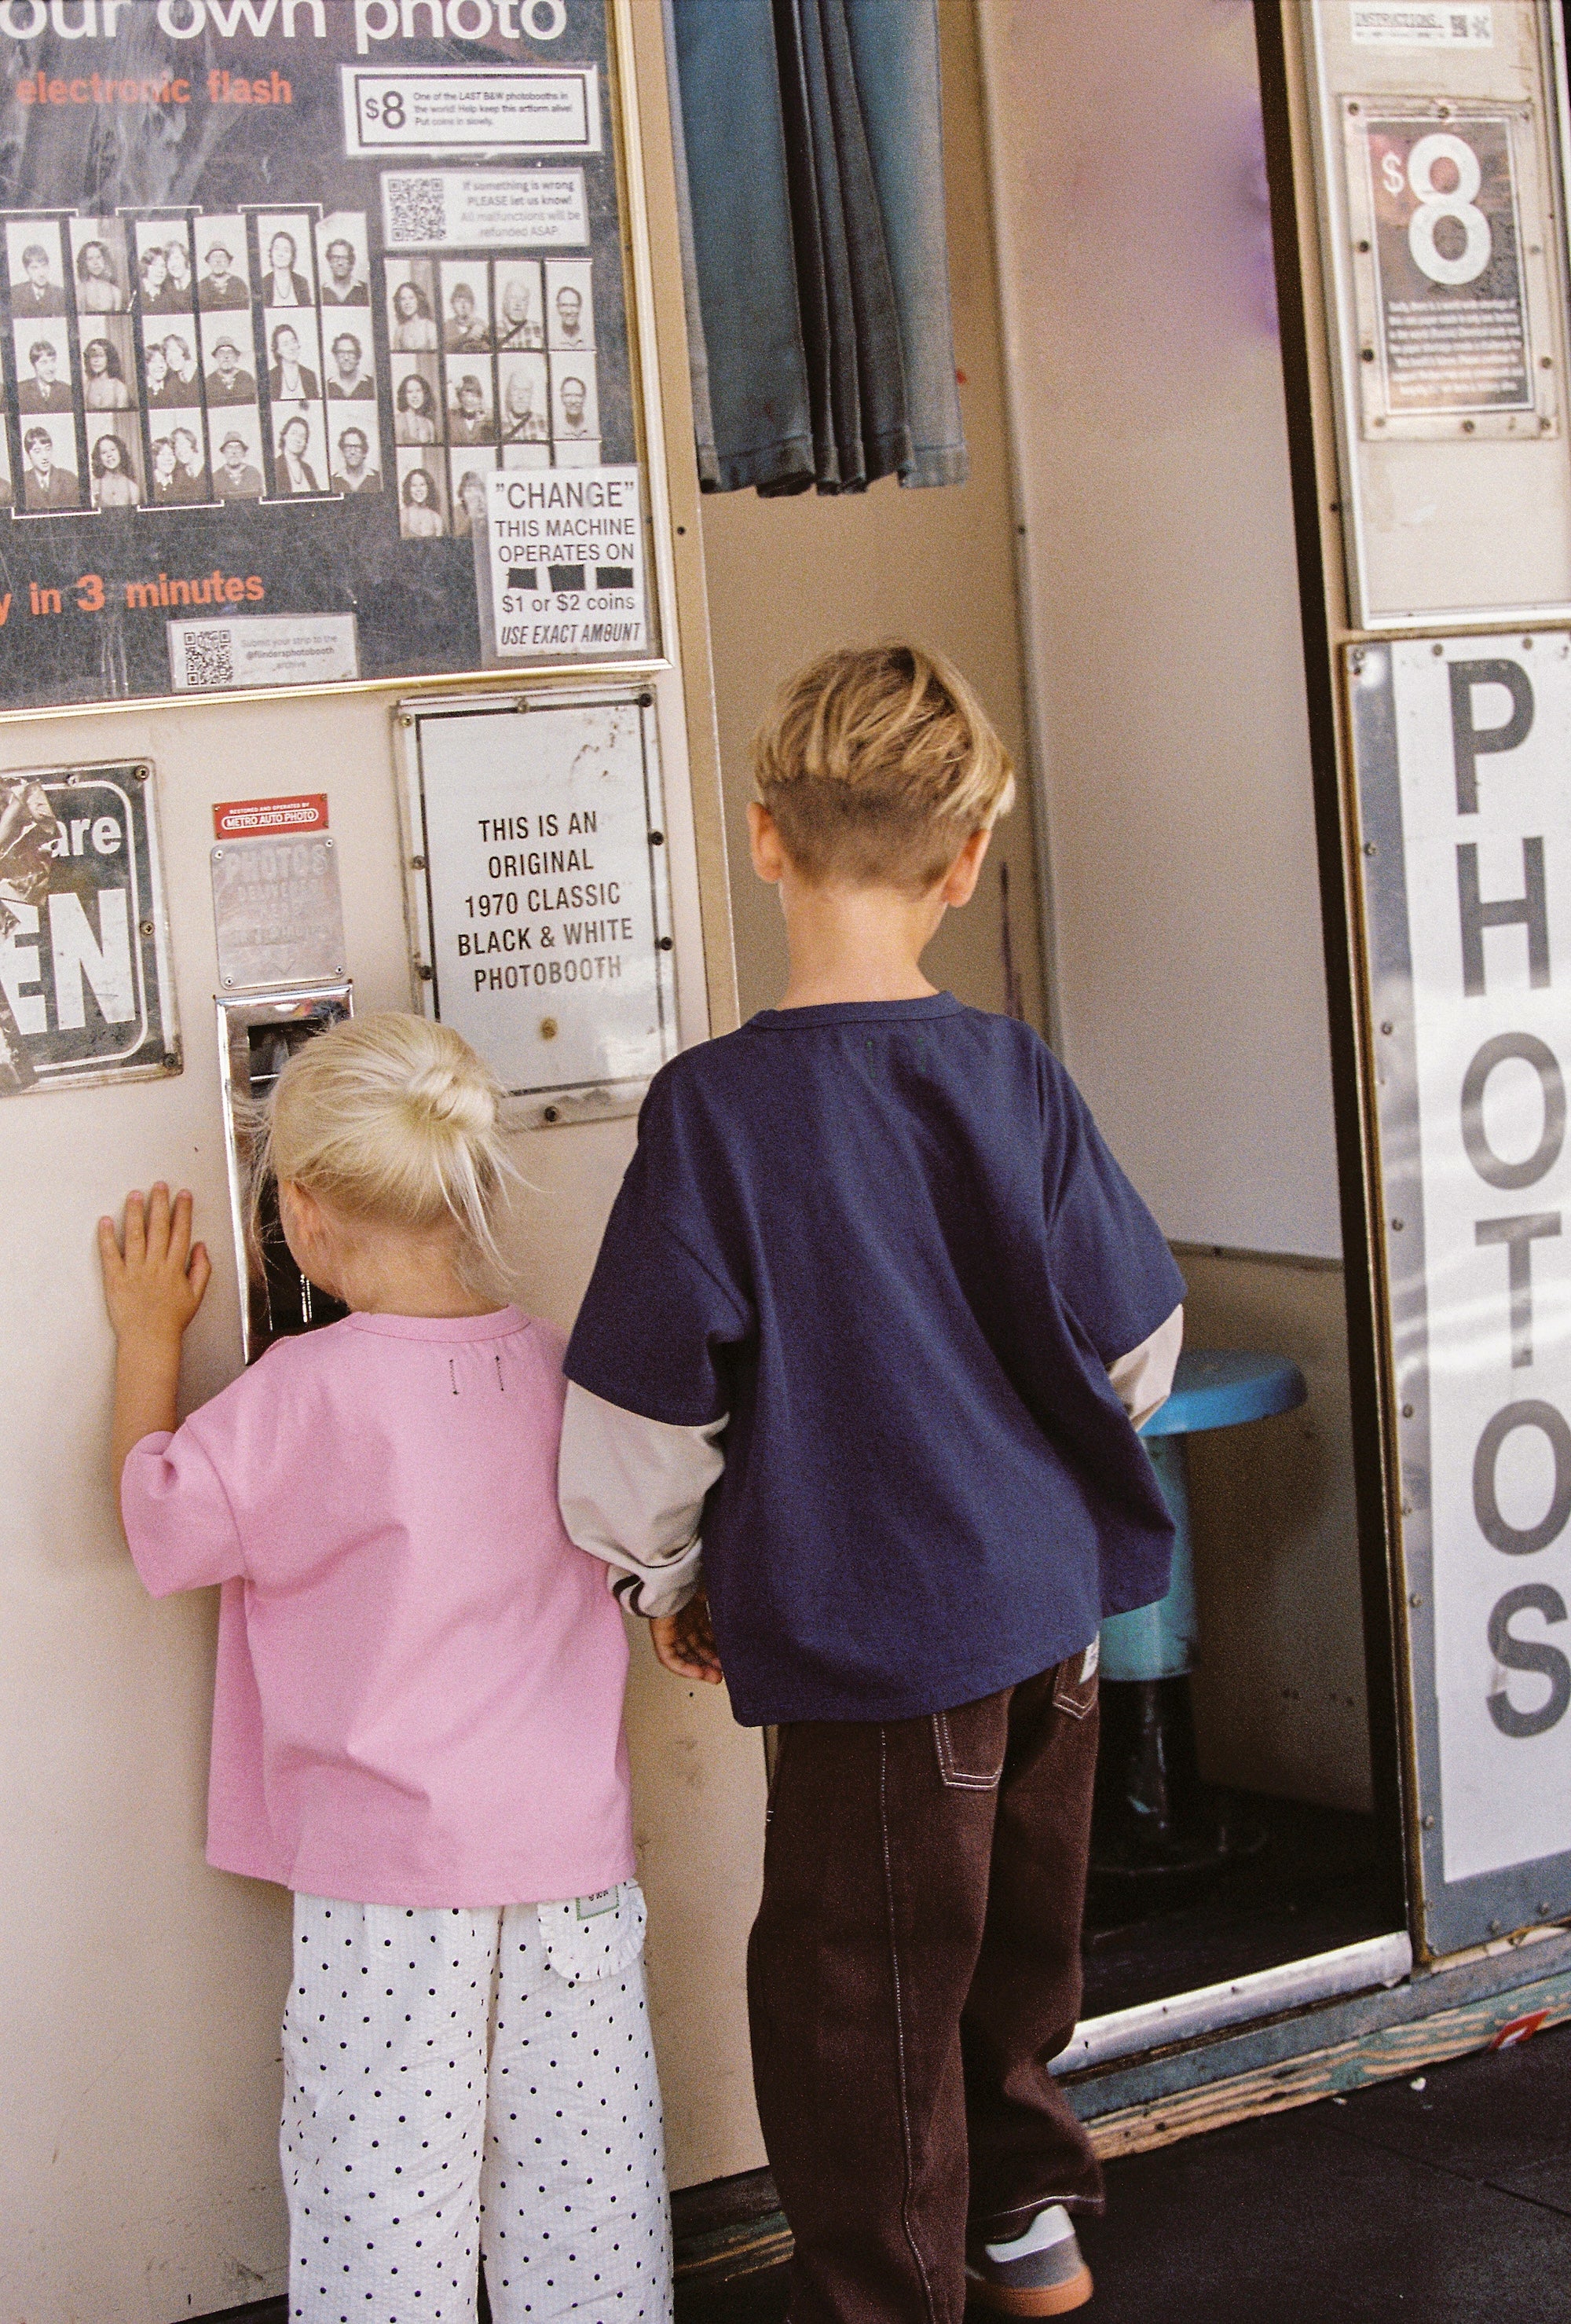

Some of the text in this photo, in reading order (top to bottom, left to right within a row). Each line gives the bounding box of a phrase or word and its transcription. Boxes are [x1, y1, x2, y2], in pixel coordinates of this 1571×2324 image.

[157, 0, 326, 39] own
[356, 0, 566, 54] photo
[16, 69, 292, 104] electronic flash
[413, 92, 430, 101] One
[443, 92, 457, 101] the
[459, 92, 481, 101] LAST
[484, 92, 503, 101] B&W
[506, 92, 558, 102] photobooths
[561, 92, 568, 101] in
[364, 90, 406, 130] $8
[414, 104, 428, 113] the
[479, 104, 500, 115] keep
[502, 104, 516, 113] this
[416, 117, 430, 126] Put
[474, 181, 529, 192] something
[532, 181, 540, 190] is
[542, 181, 574, 192] wrong
[467, 196, 508, 206] PLEASE
[511, 196, 524, 206] let
[527, 197, 540, 206] us
[1383, 133, 1492, 285] $8
[547, 210, 565, 221] will
[567, 211, 580, 221] be
[480, 226, 528, 237] refunded
[494, 519, 635, 537] THIS MACHINE
[499, 543, 634, 563] OPERATES ON
[29, 582, 61, 615] in
[77, 574, 105, 611] 3
[126, 570, 265, 609] minutes
[502, 592, 635, 614] $1 or $2 coins
[501, 622, 641, 645] USE EXACT AMOUNT
[226, 811, 315, 827] METRO AUTO PHOTO
[479, 811, 597, 842] THIS IS AN
[489, 849, 594, 878] ORIGINAL
[465, 882, 621, 918] 1970 CLASSIC
[458, 917, 634, 956] BLACK & WHITE
[474, 955, 621, 992] PHOTOBOOTH
[1448, 658, 1571, 1739] PHOTOS
